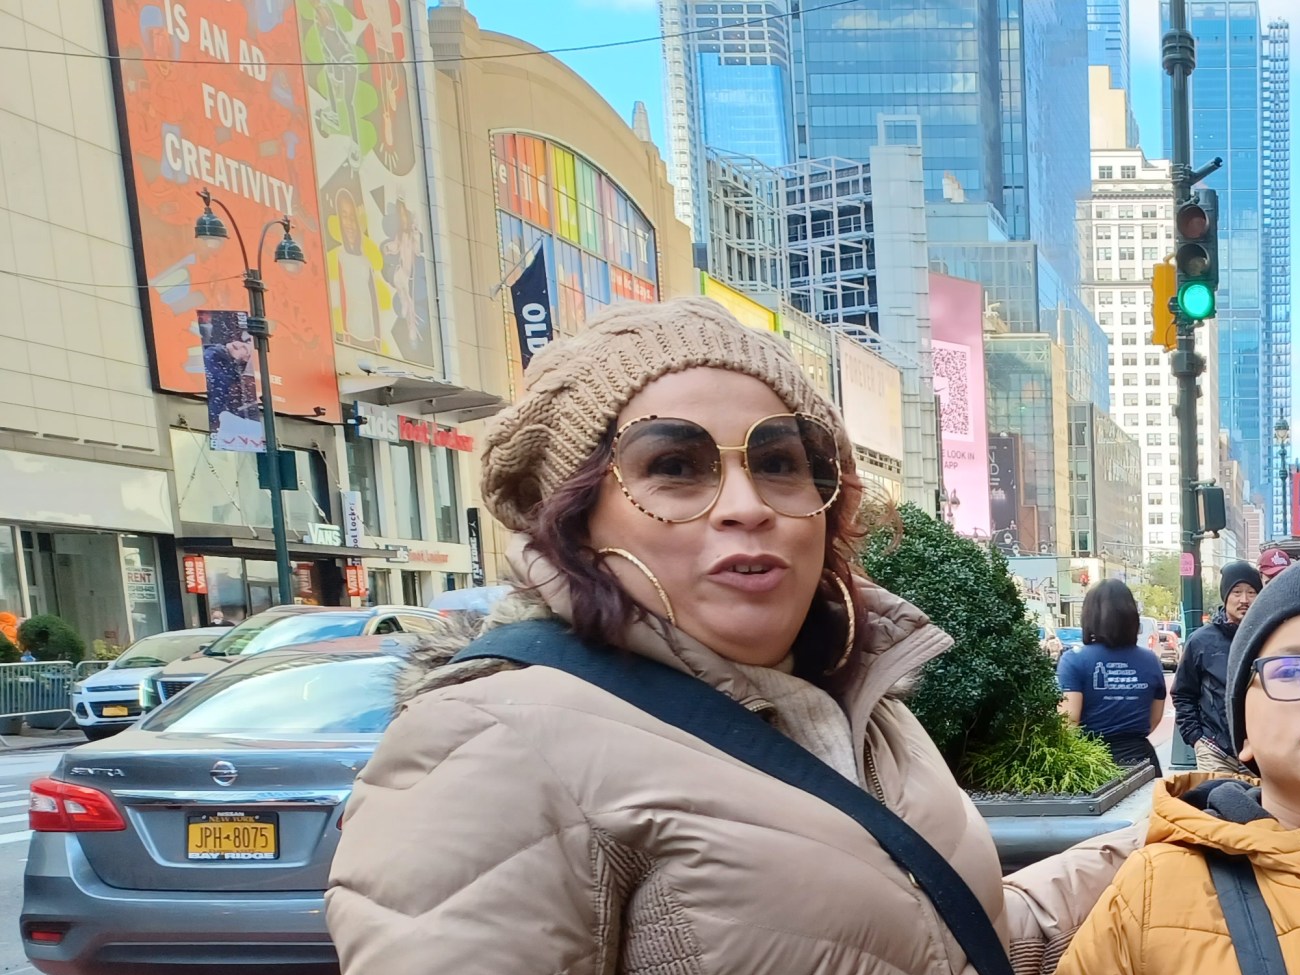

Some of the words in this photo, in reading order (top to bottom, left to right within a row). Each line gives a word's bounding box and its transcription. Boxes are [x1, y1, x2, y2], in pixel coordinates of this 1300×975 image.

[164, 0, 190, 42] IS
[199, 17, 230, 63] AN
[239, 38, 267, 82] AD
[201, 82, 249, 136] FOR
[165, 132, 293, 216] CREATIVITY
[522, 302, 550, 355] OLD
[362, 403, 398, 441] kids
[399, 414, 430, 444] foot
[944, 461, 958, 470] APP
[946, 450, 968, 460] LOOK
[968, 451, 975, 461] IN
[307, 522, 343, 547] VANS
[127, 572, 152, 583] RENT
[184, 559, 196, 589] VANS
[196, 561, 207, 589] VANS
[195, 827, 222, 849] JPH
[233, 826, 269, 849] 8075
